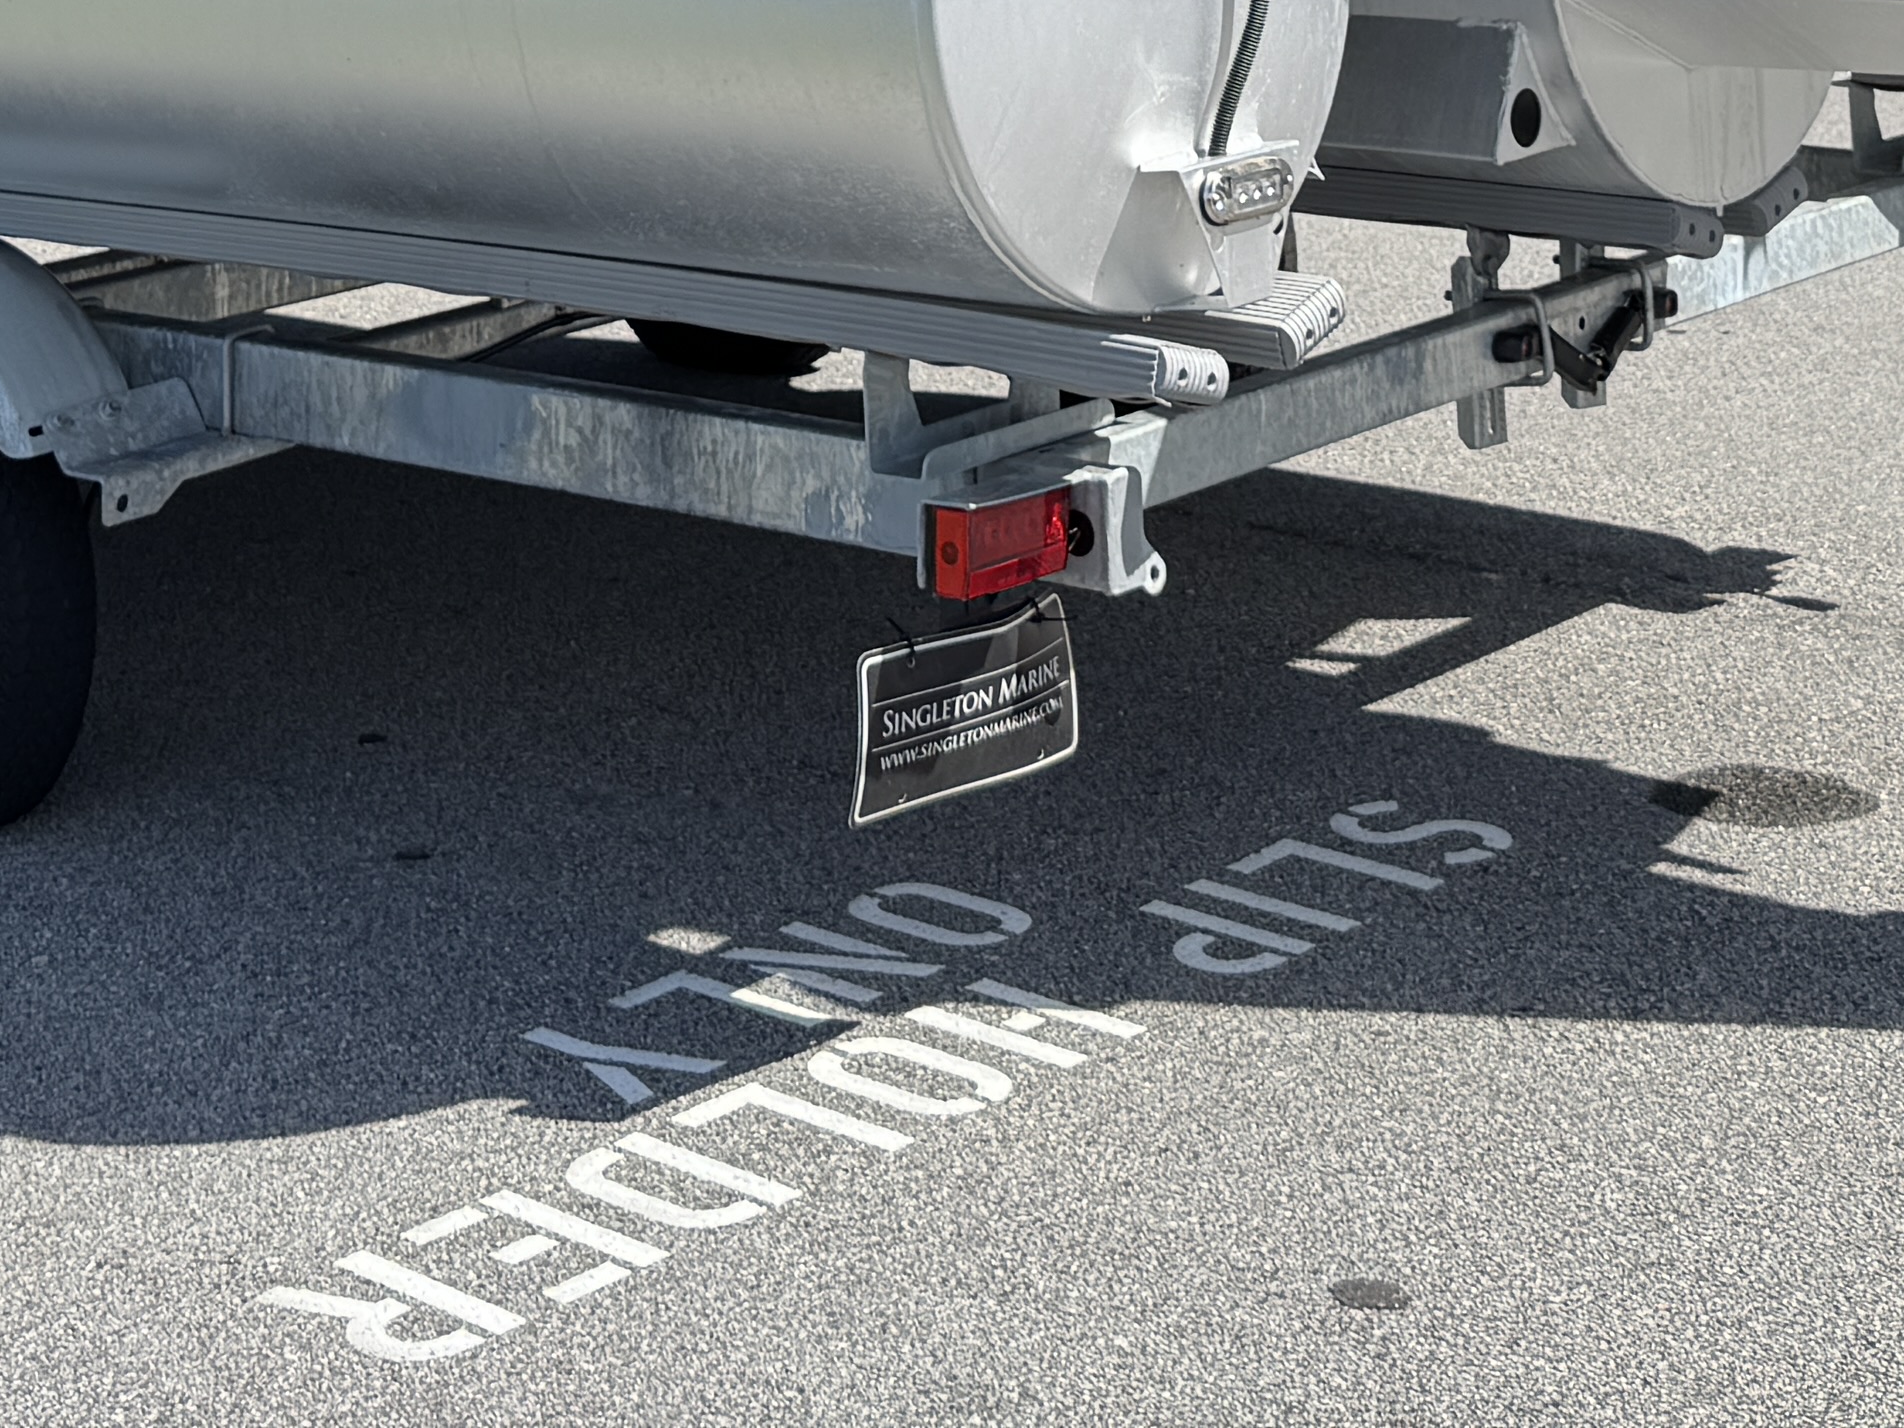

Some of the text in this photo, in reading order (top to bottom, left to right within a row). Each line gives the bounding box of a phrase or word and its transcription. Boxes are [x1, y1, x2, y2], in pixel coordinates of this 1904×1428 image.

[880, 695, 1065, 771] WWW.SINGLETONMARINE.COM
[881, 655, 1062, 738] SINGLETON MARINE
[520, 882, 1033, 1106] ONLY
[252, 800, 1514, 1362] SLIP HOLDER
